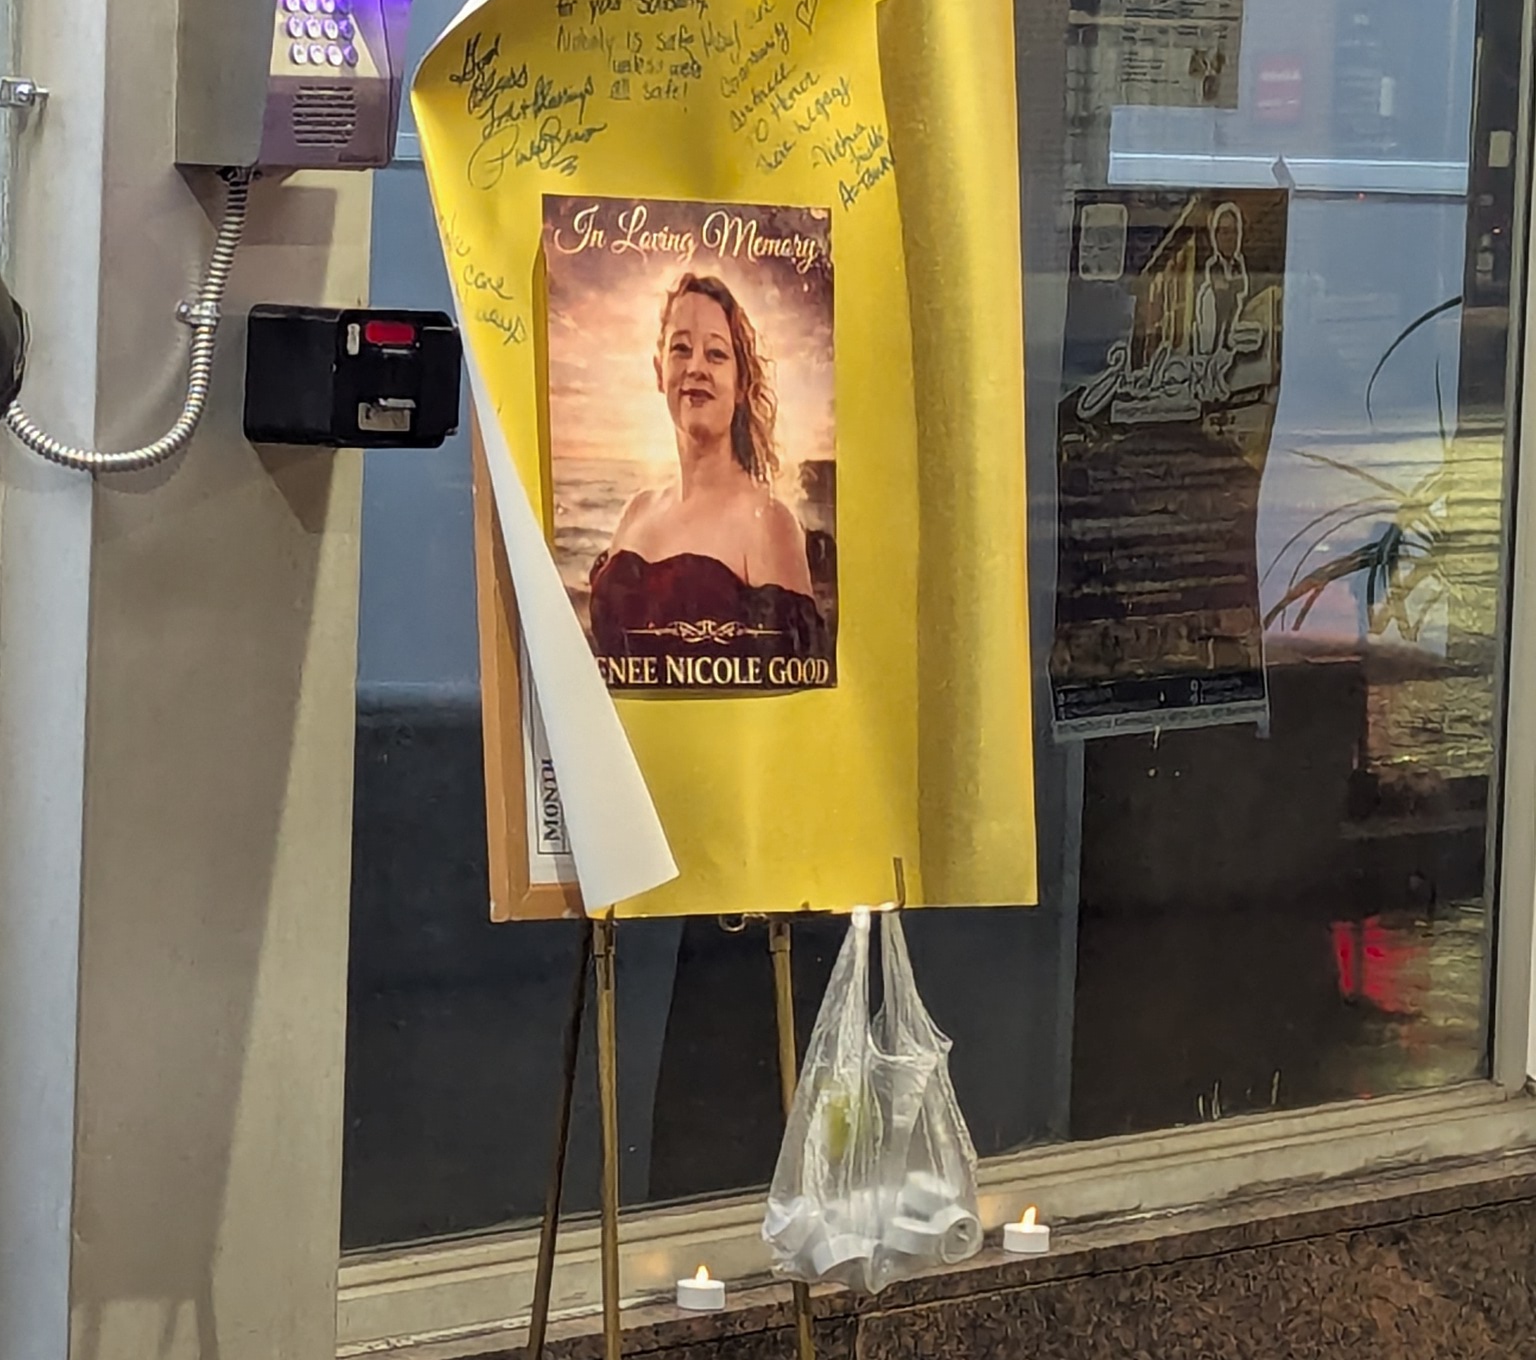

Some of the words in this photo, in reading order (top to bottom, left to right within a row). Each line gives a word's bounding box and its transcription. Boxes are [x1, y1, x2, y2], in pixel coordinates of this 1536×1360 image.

[554, 204, 605, 255] In
[611, 204, 698, 266] Loving
[702, 209, 820, 274] Memory
[665, 653, 763, 685] NICOLE
[768, 655, 830, 685] GOOD
